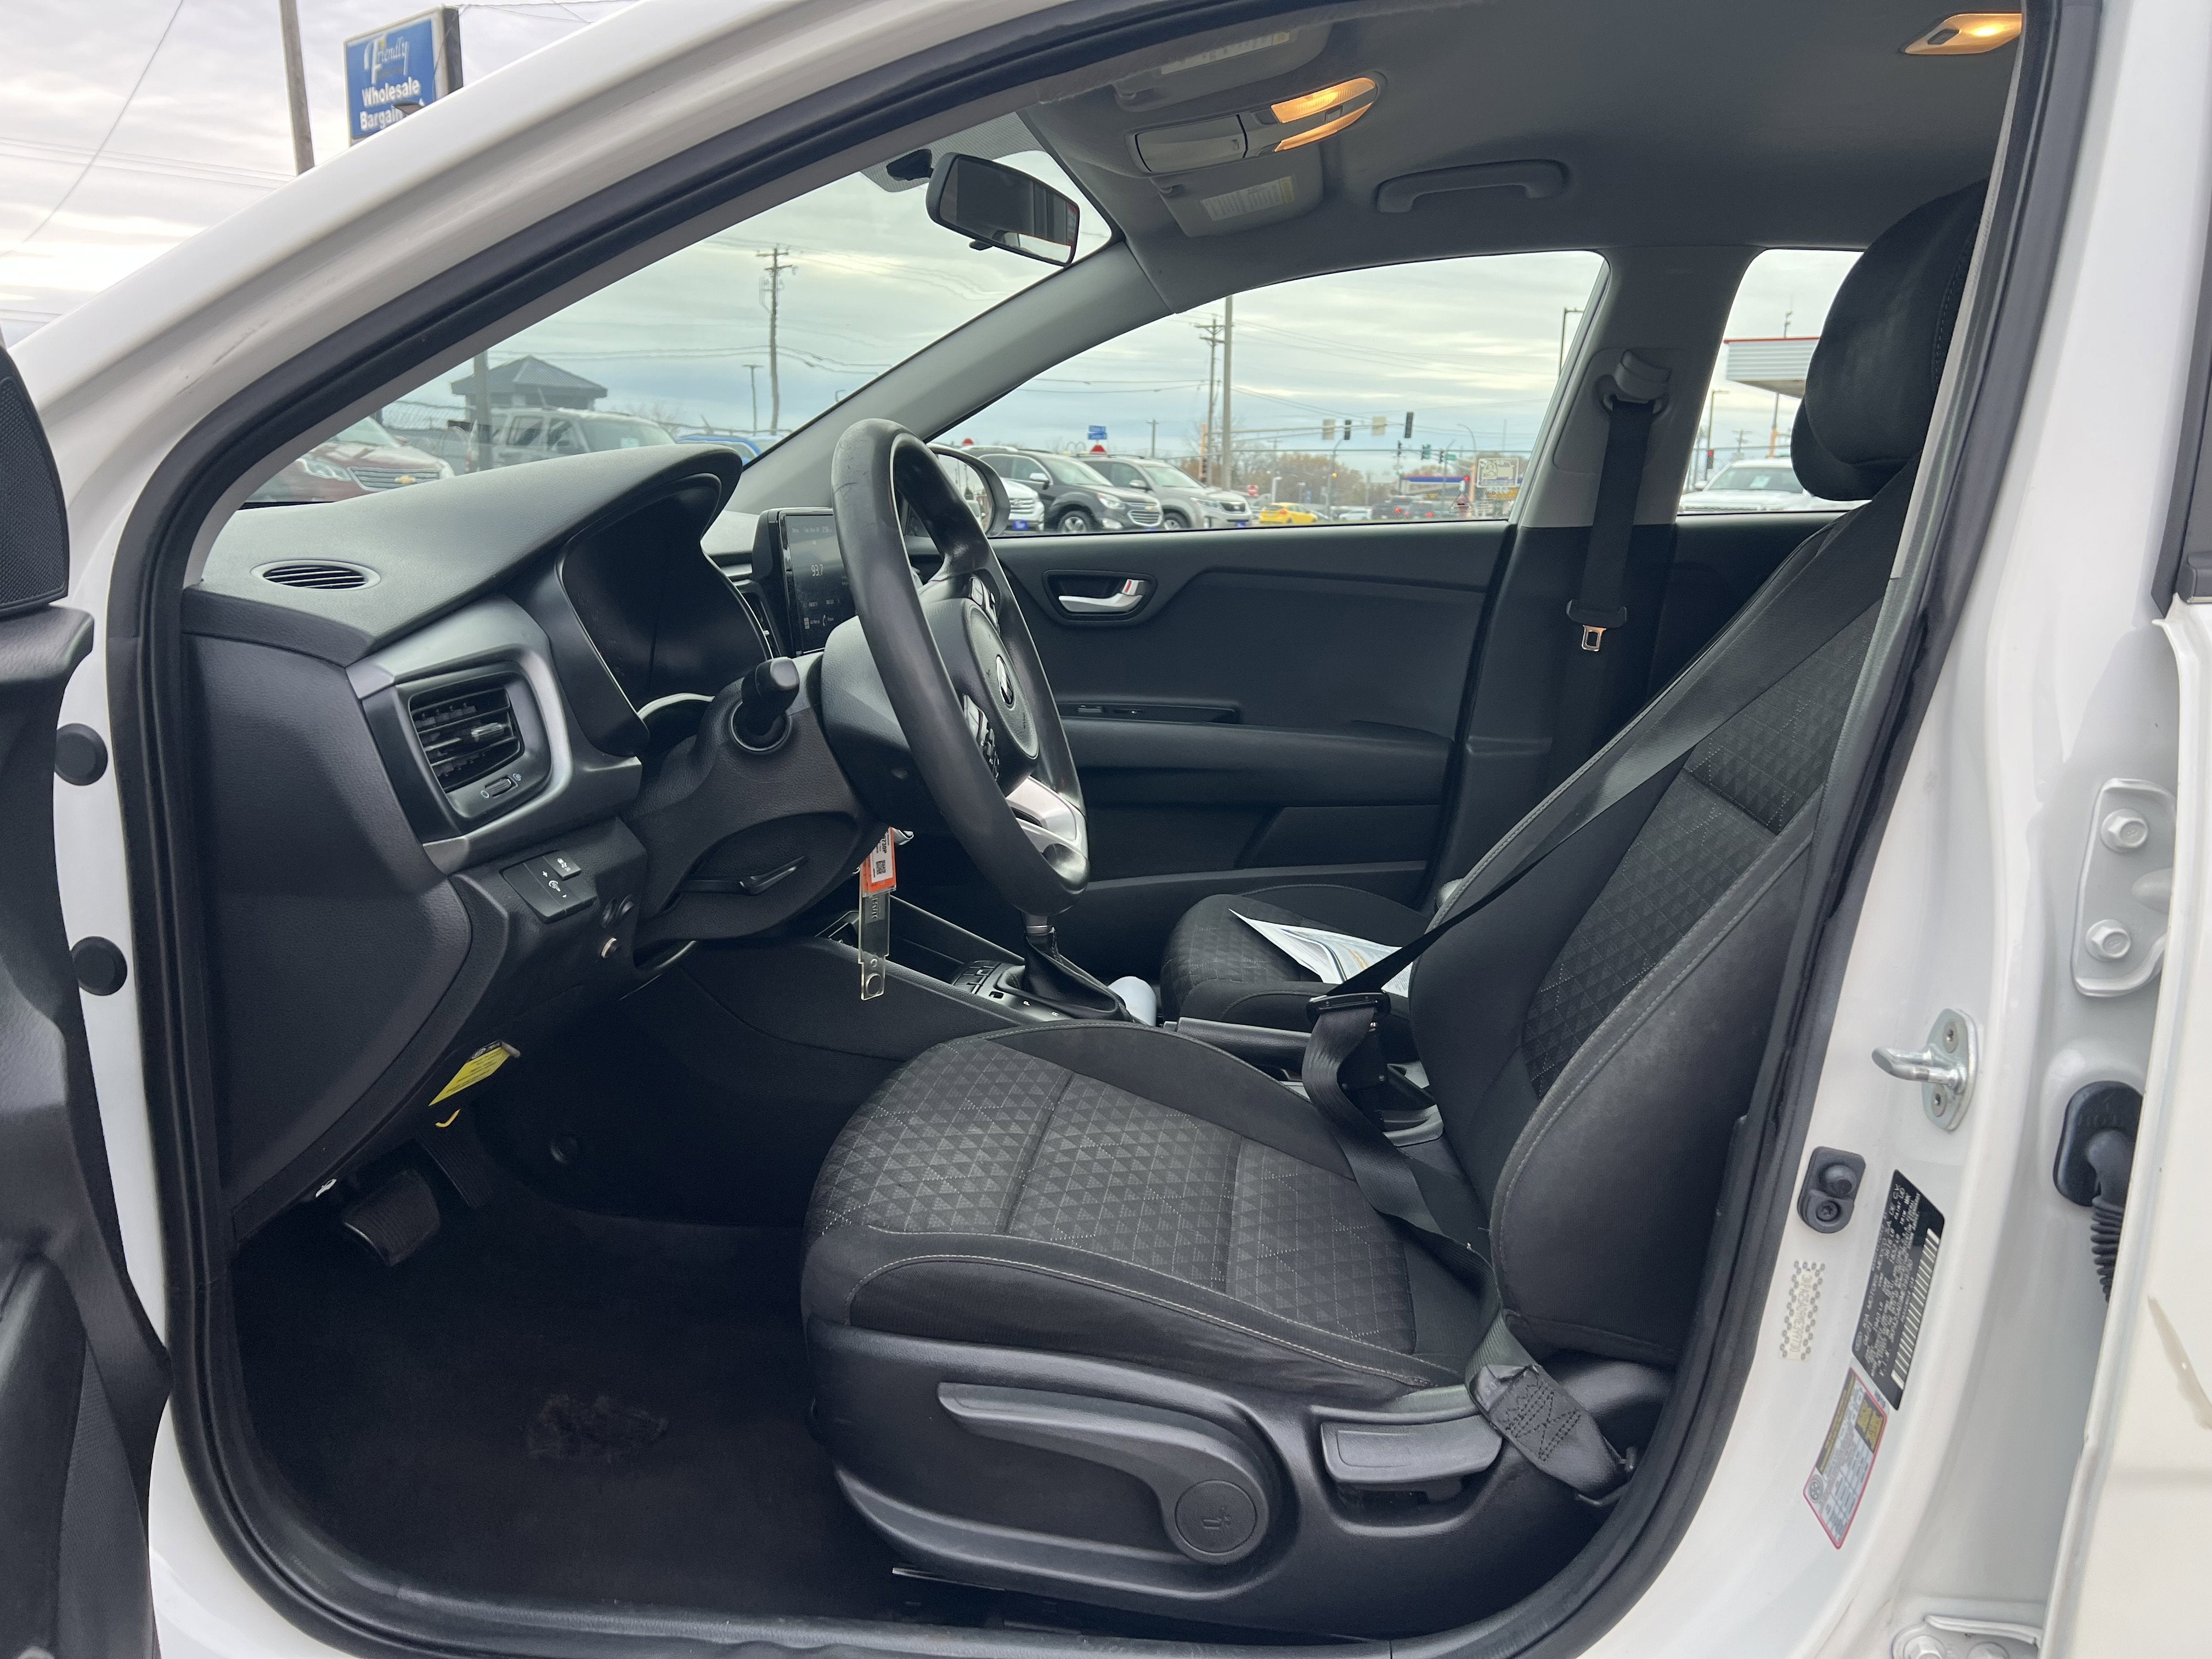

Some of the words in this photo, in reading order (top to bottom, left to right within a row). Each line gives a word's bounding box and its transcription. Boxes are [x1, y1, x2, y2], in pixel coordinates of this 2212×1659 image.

[364, 36, 409, 84] Friendly
[362, 76, 421, 107] Wholesale
[811, 564, 823, 577] 93.7
[1867, 1274, 1878, 1309] MOTORS
